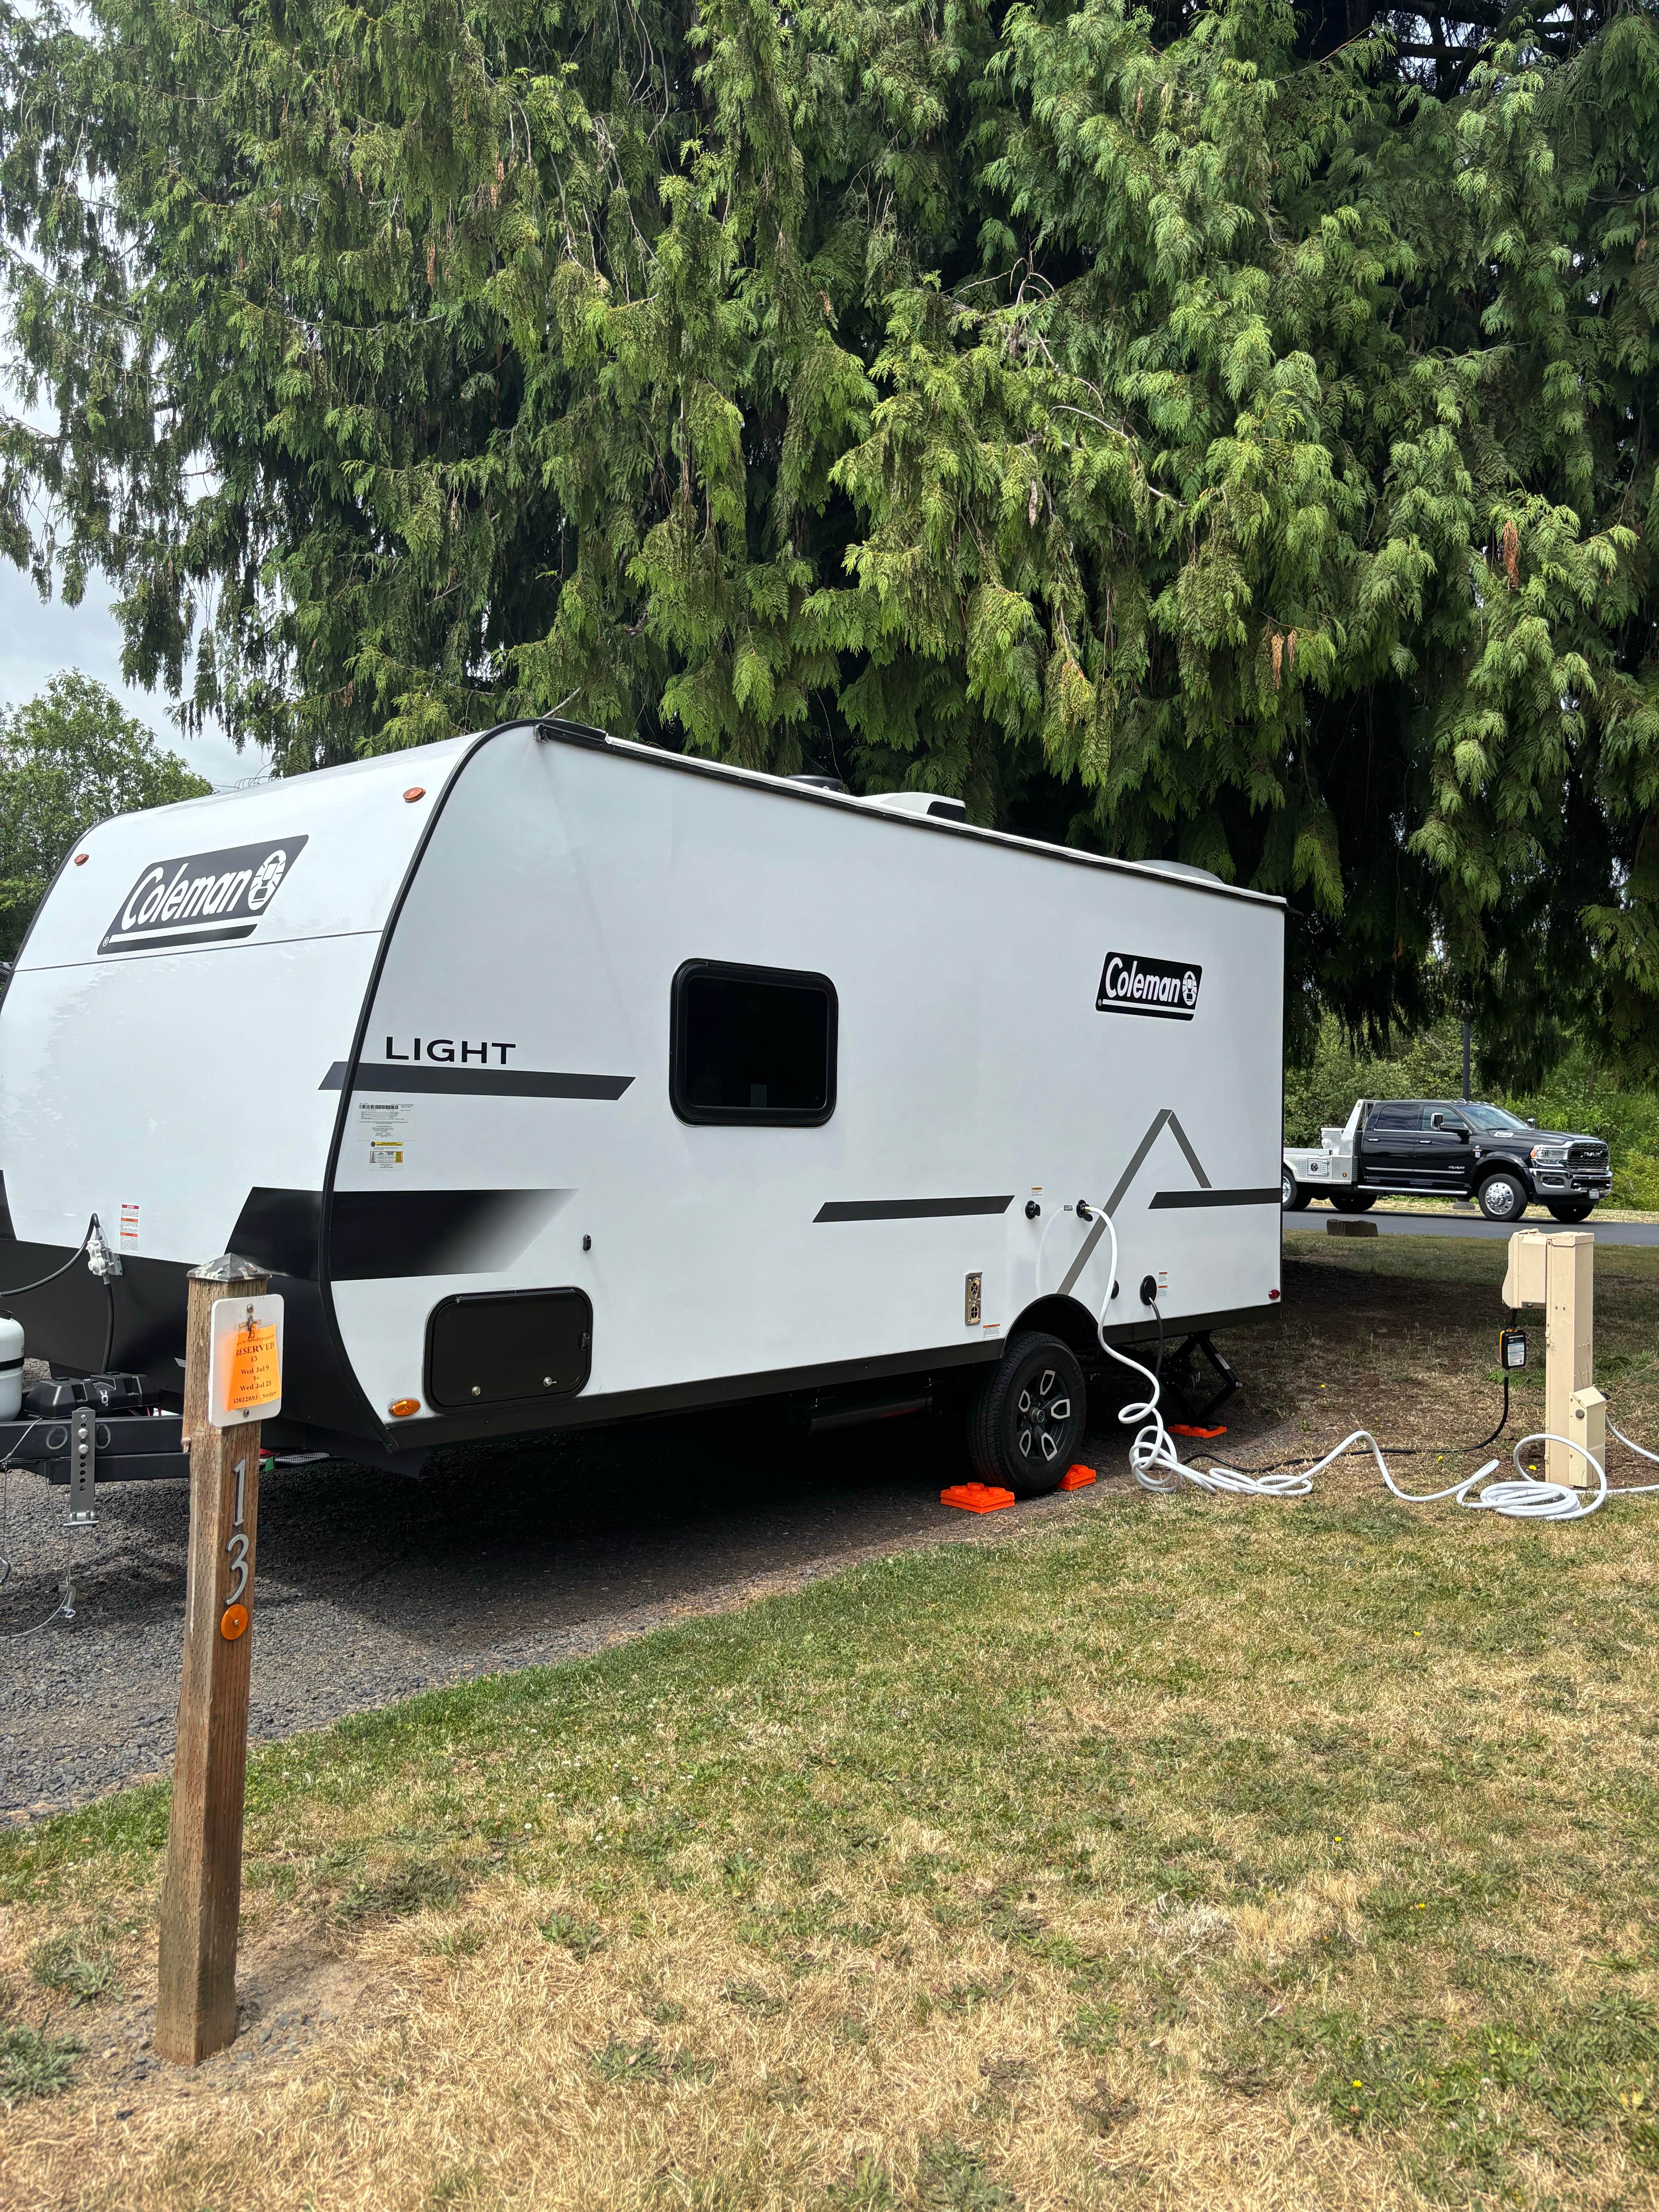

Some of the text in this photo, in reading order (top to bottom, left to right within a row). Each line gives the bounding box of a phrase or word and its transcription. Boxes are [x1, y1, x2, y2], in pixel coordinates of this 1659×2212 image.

[121, 863, 252, 931] Coleman
[1105, 957, 1180, 1003] Coleman
[386, 1036, 516, 1065] LIGHT
[236, 1342, 274, 1357] RESERVED
[234, 1395, 258, 1404] 12022893
